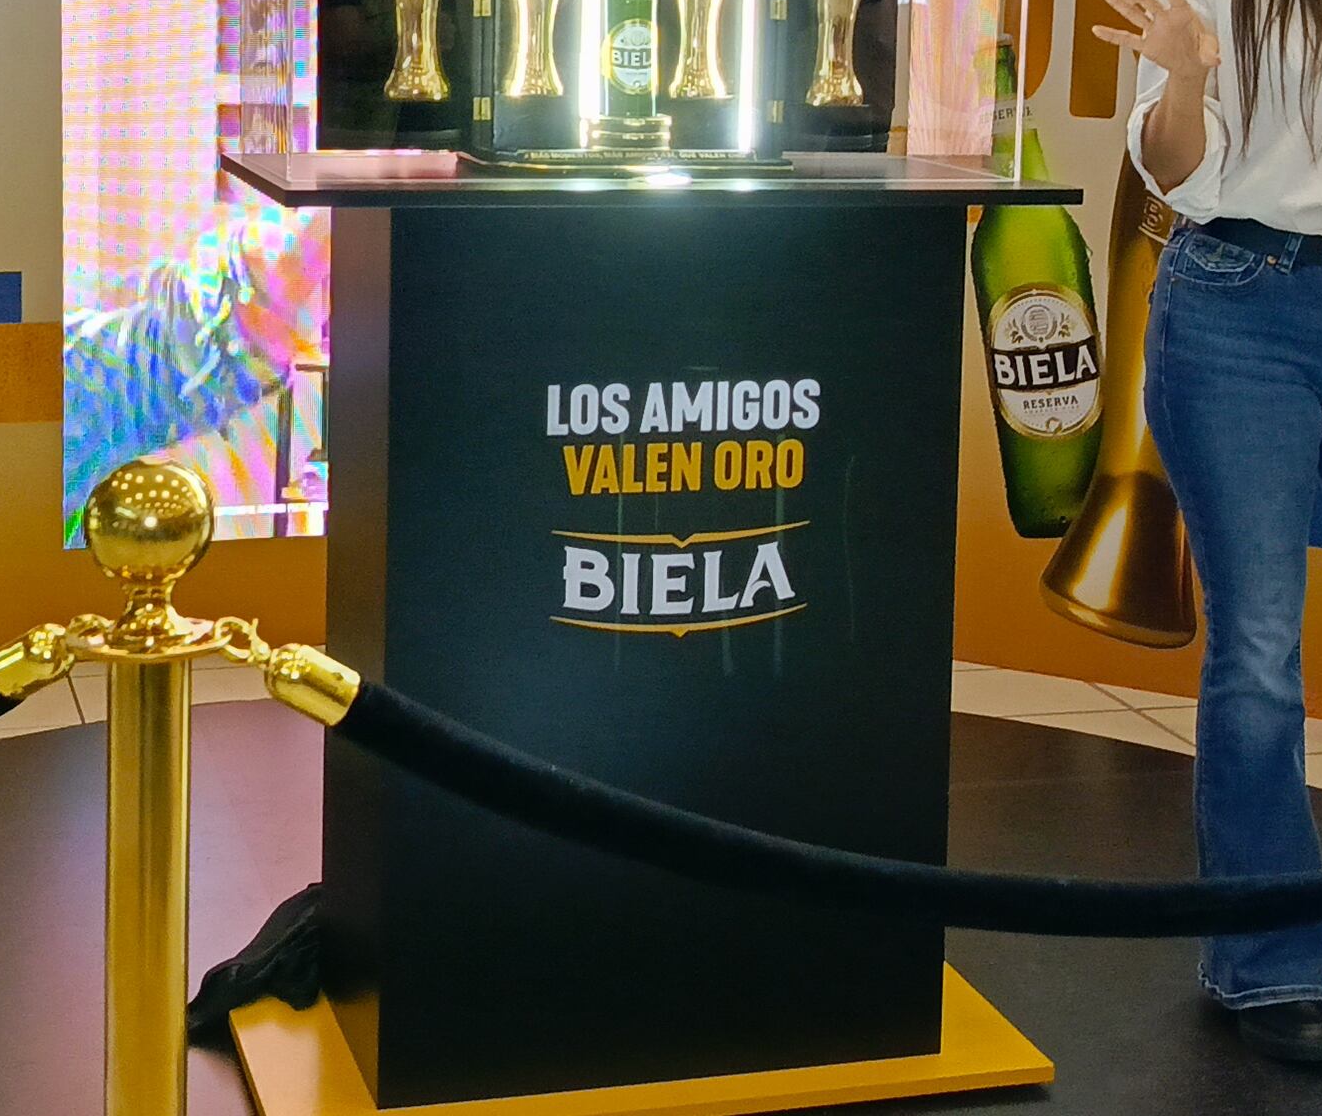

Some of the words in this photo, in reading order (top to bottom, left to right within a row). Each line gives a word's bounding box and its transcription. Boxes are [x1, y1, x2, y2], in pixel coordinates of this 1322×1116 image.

[994, 344, 1098, 387] BIELA
[546, 382, 631, 436] LOS
[639, 378, 822, 434] AMIGOS
[1023, 395, 1079, 410] RESERVA
[562, 441, 702, 496] VALEN
[713, 438, 805, 491] ORO
[562, 540, 797, 616] BIELA
